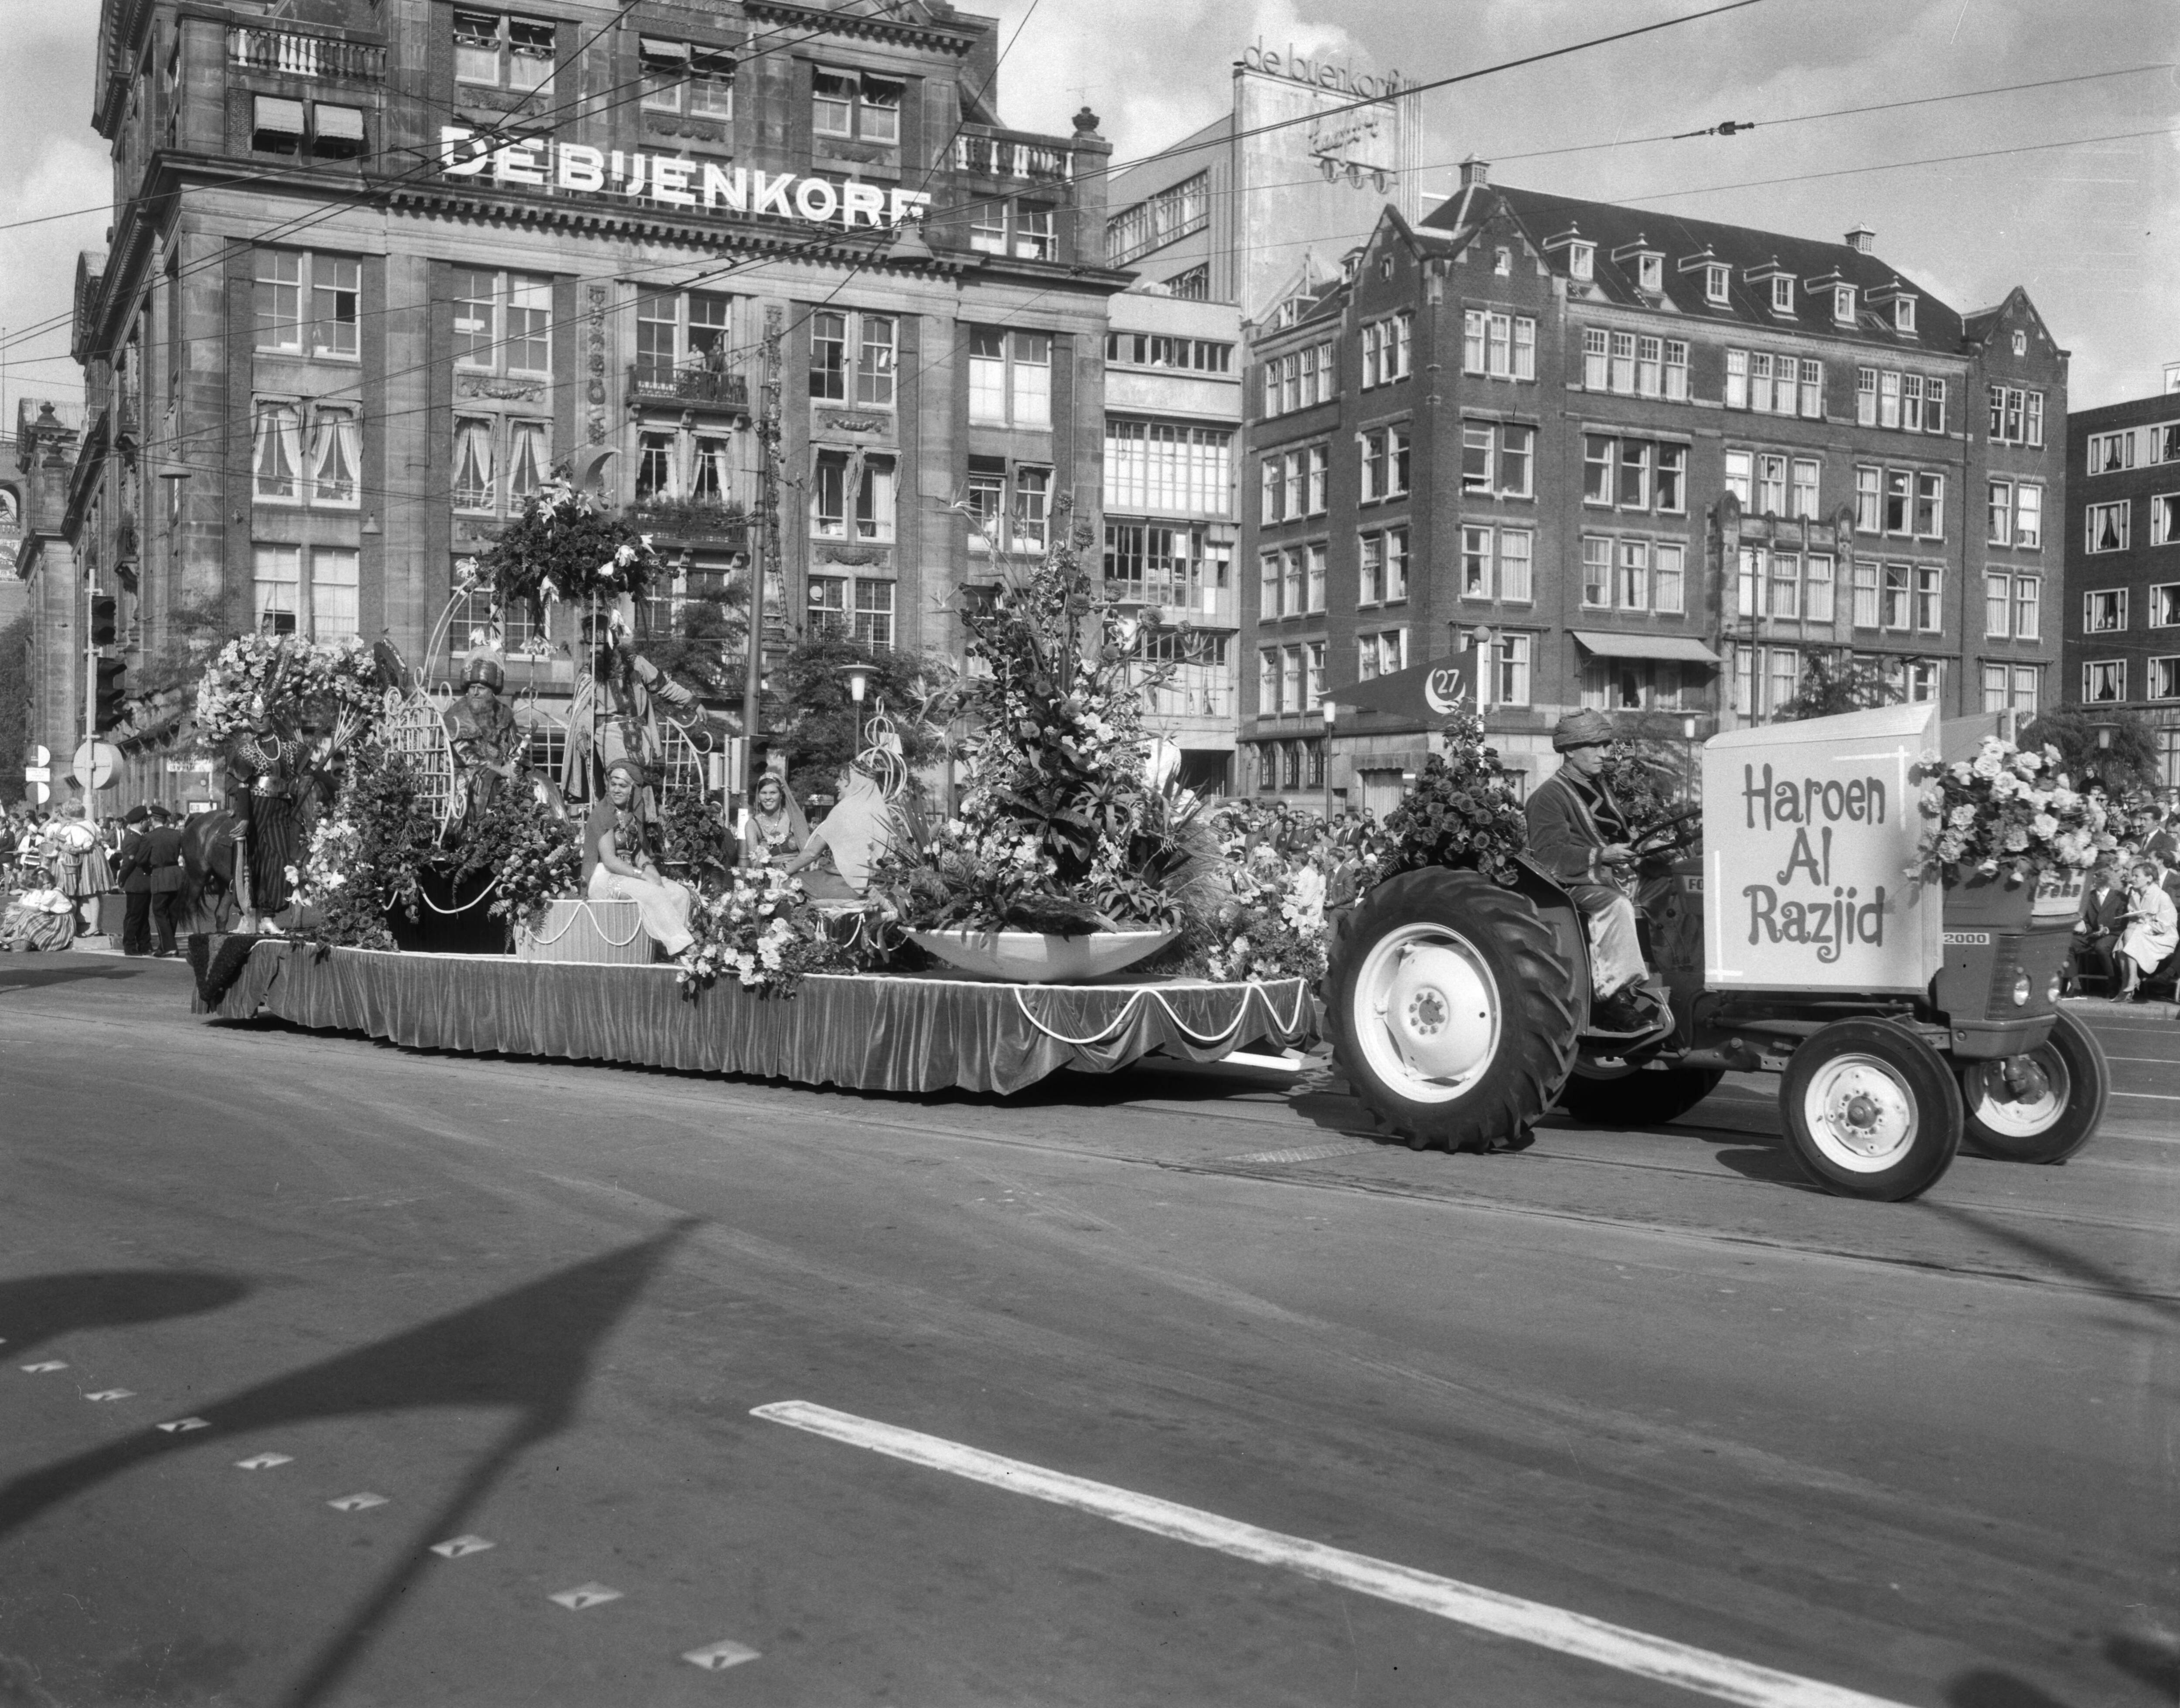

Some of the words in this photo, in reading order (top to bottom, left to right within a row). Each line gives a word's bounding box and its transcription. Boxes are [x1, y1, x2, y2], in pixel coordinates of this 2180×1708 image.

[1243, 35, 1281, 75] de
[441, 126, 544, 185] DE
[559, 142, 931, 232] BIJENKORF
[1436, 668, 1460, 694] 27
[1741, 763, 1886, 831] Haroen
[1776, 826, 1833, 886] Al
[1742, 884, 1886, 964] Razjid
[1944, 934, 1986, 944] 2000
